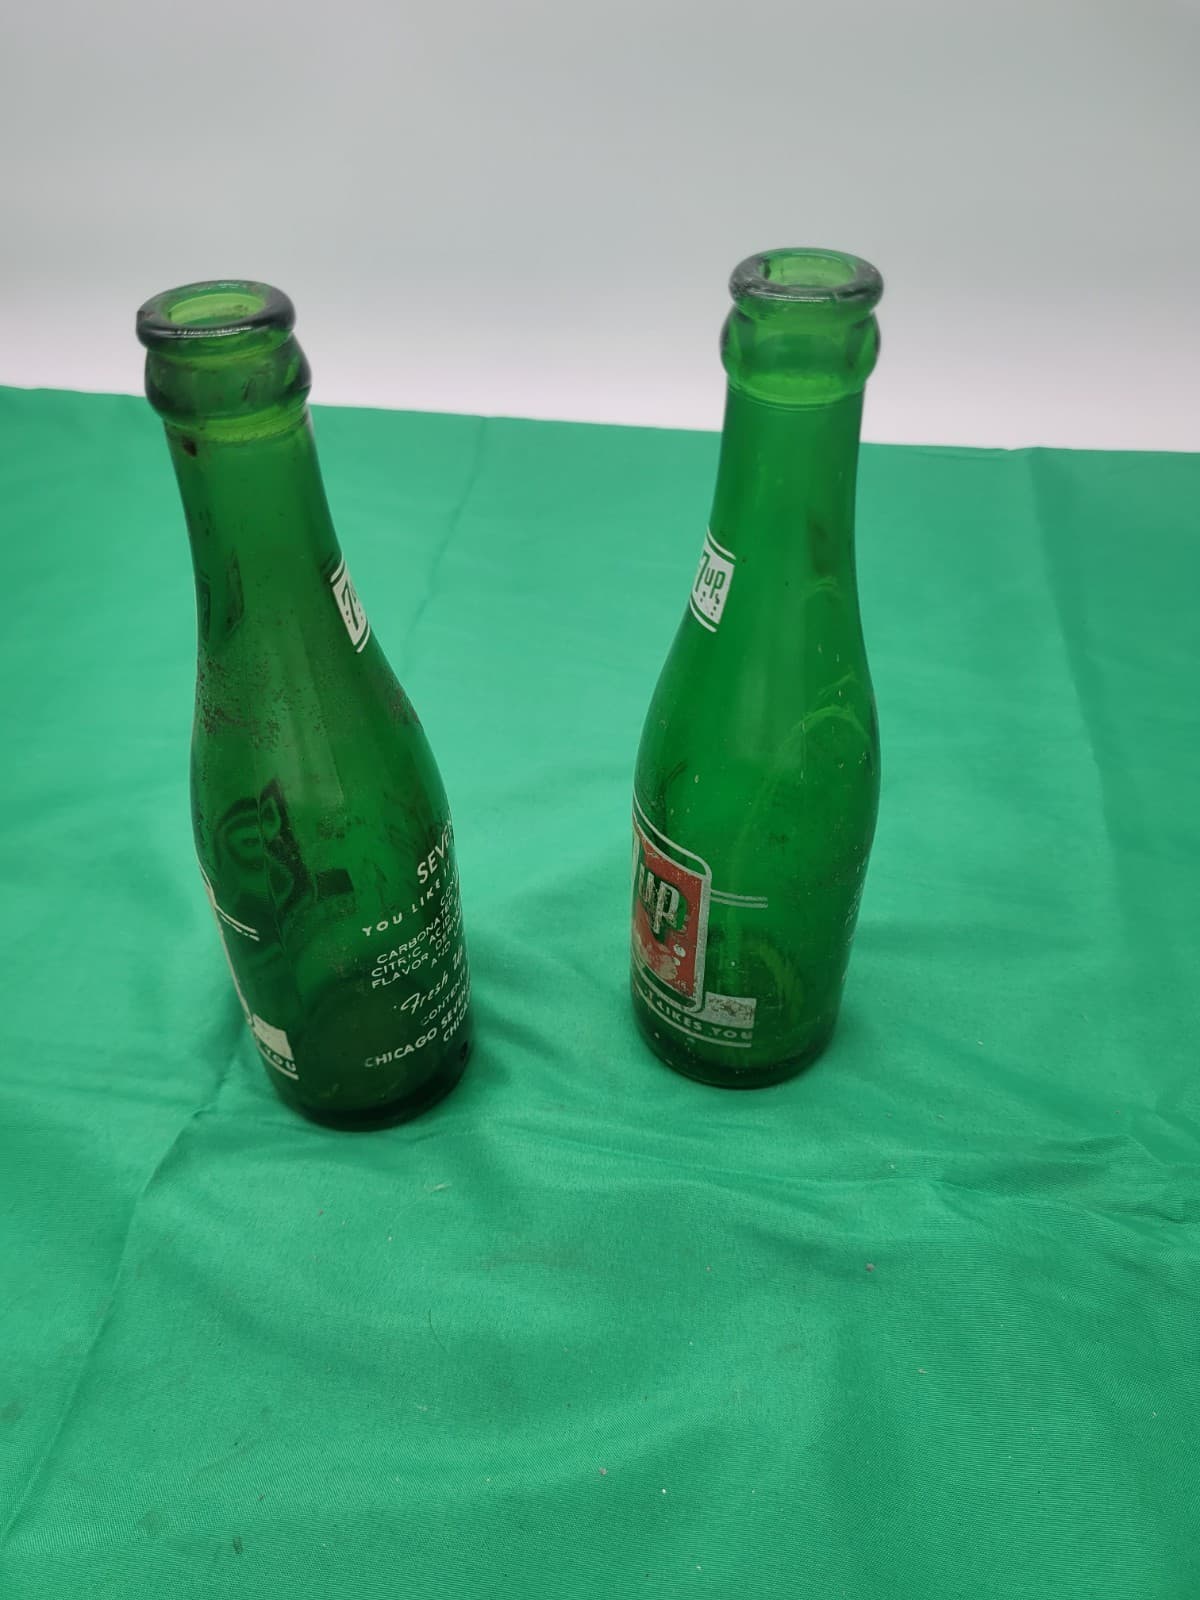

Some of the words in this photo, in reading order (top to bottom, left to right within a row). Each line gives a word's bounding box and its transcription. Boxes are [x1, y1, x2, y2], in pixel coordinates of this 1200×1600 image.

[362, 912, 402, 937] YOU
[411, 878, 441, 914] LIKE
[655, 1000, 703, 1031] LIKES
[711, 1026, 753, 1040] YOU
[364, 1027, 438, 1067] CHICAGO
